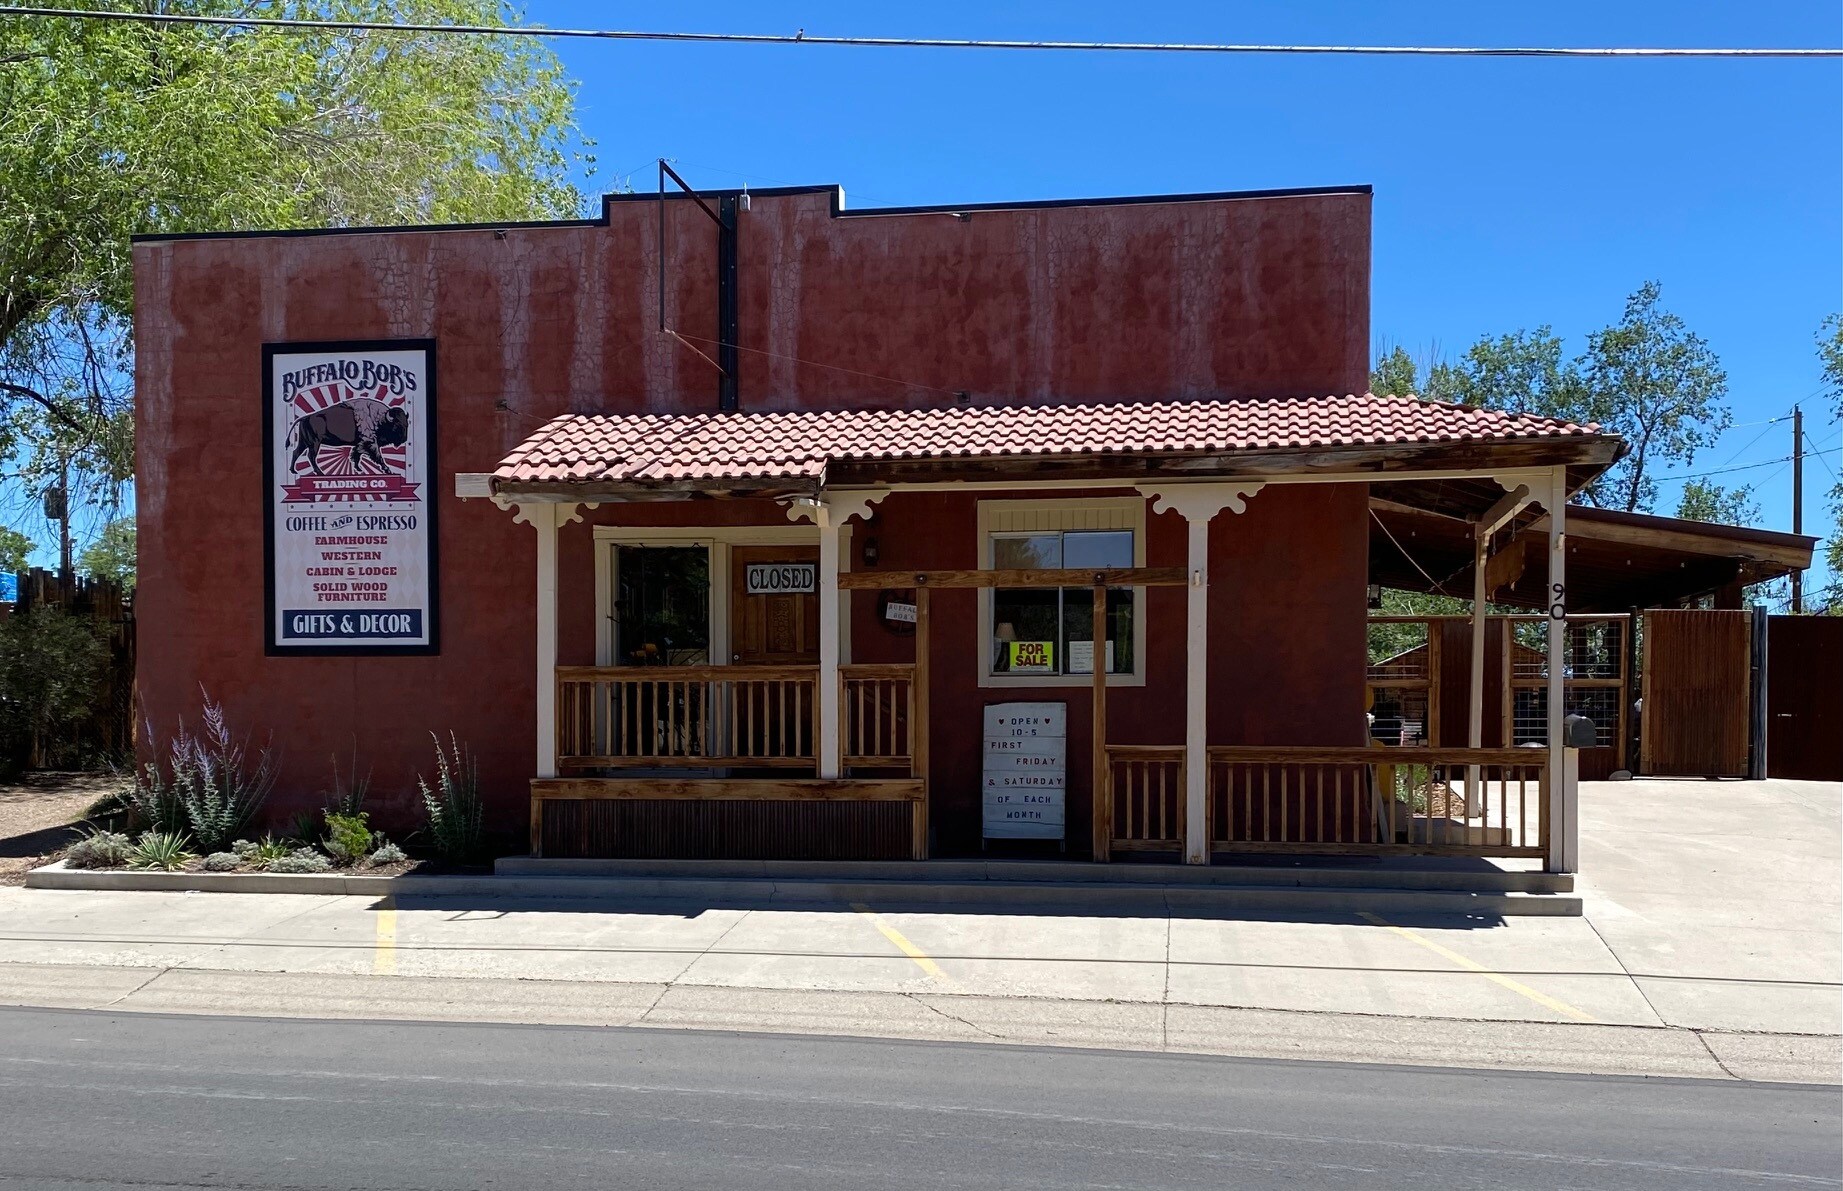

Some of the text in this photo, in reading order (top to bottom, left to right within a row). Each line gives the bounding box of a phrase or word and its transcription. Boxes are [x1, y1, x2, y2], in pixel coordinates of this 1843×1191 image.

[282, 360, 417, 402] BUFFALO BOB'S
[313, 480, 388, 489] TRADING CO.
[285, 515, 417, 531] COFFEE AND ESPRESSO
[314, 536, 388, 545] FARMHOUSE
[321, 551, 382, 560] WESTERN
[306, 566, 397, 576] CABIN & LODGE
[750, 568, 813, 590] CLOSED
[313, 582, 388, 591] SOLID WOOD
[318, 593, 387, 602] FURNITURE
[1550, 583, 1567, 621] 90
[888, 604, 917, 613] BUFFAL
[293, 614, 411, 633] GIFTS & DECOR
[1019, 643, 1044, 655] FOR
[1015, 655, 1048, 667] SALE
[1011, 717, 1039, 726] OPEN
[991, 741, 1022, 749] FIRST
[1004, 777, 1062, 786] SATURDAY
[997, 795, 1051, 803] OF EACH
[1006, 811, 1041, 819] MONTH
